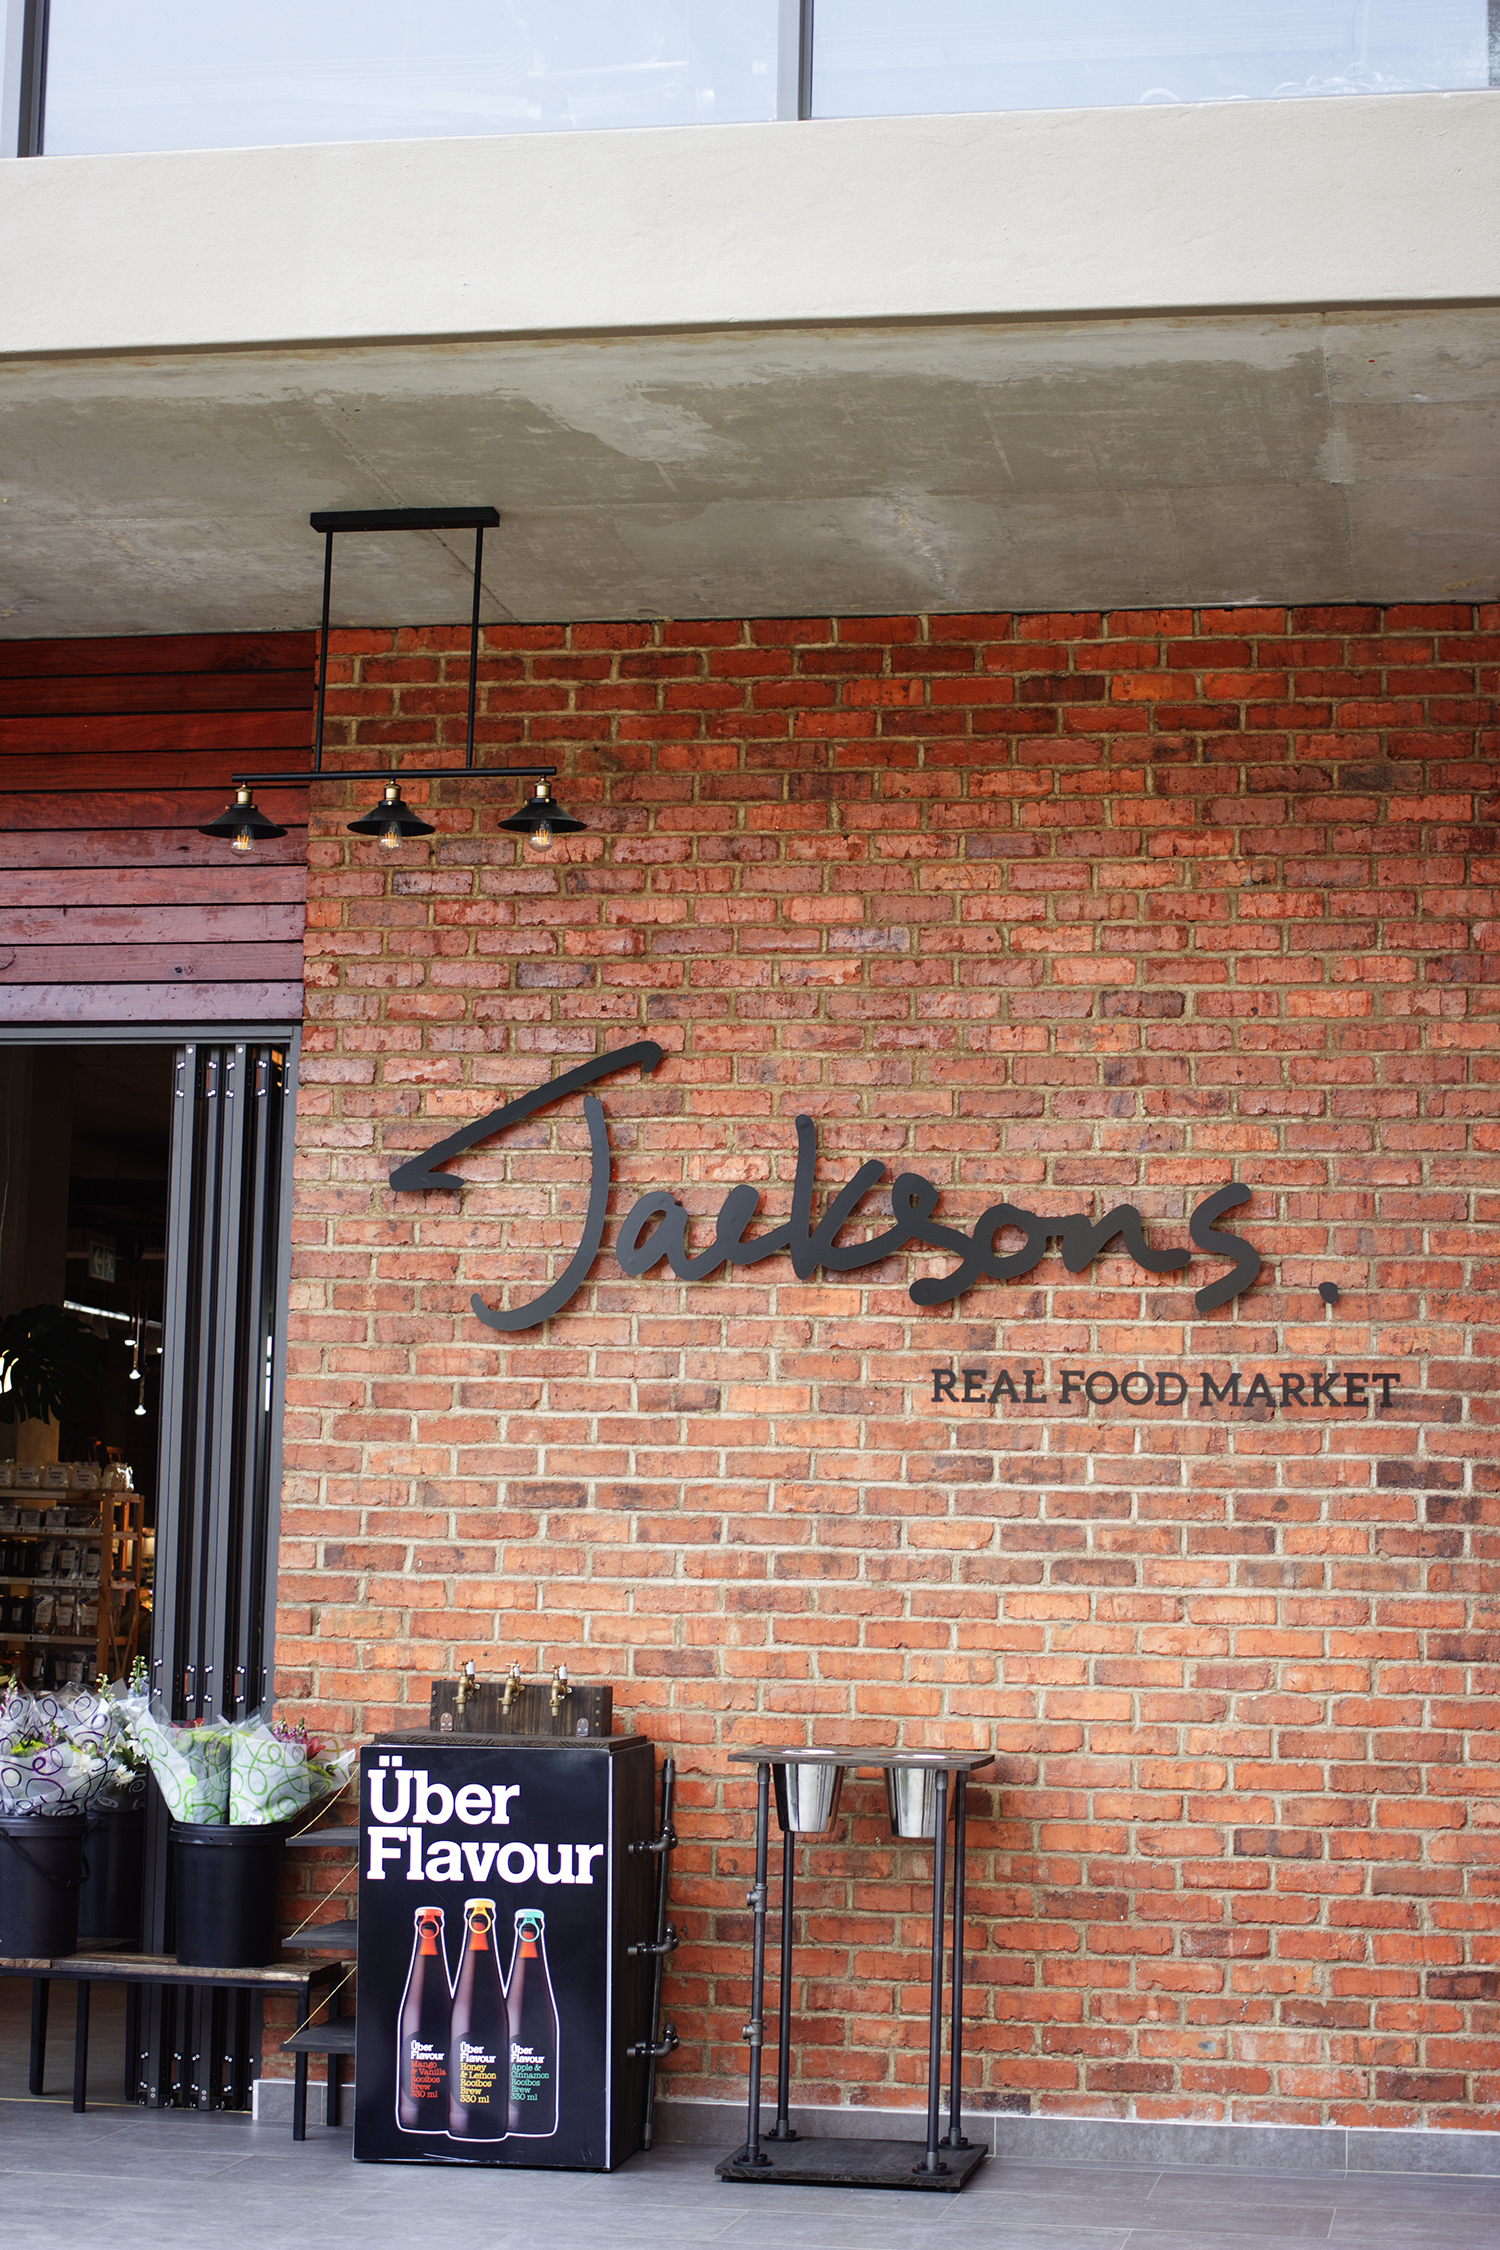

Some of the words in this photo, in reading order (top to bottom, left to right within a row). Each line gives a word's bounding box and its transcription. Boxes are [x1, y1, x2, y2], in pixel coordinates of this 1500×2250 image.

[931, 1368, 1047, 1404] REAL
[1059, 1369, 1188, 1406] FOOD
[1200, 1372, 1401, 1408] MARKET
[367, 1755, 520, 1825] Über
[366, 1826, 604, 1884] Flavour
[410, 2040, 434, 2051] Über
[460, 2041, 485, 2054] Über
[510, 2043, 534, 2054] Über
[410, 2051, 445, 2060] Flavour
[459, 2053, 497, 2063] Flavour
[510, 2054, 546, 2063] Flavour
[410, 2060, 437, 2069] Mango
[460, 2063, 487, 2073] Honey
[511, 2064, 533, 2072] Apple
[410, 2067, 418, 2075] &
[418, 2068, 446, 2076] Vanilla
[460, 2071, 468, 2079] &
[468, 2071, 497, 2079] Lemon
[510, 2071, 550, 2079] Cinnamon
[410, 2075, 440, 2083] Rooibos
[460, 2079, 493, 2088] Rooibos
[511, 2078, 541, 2087] Rooibos
[410, 2082, 431, 2090] Brew
[410, 2089, 426, 2098] 330
[460, 2087, 482, 2095] Brew
[460, 2095, 477, 2103] 330
[477, 2095, 490, 2104] ml
[510, 2093, 526, 2101] 330
[527, 2093, 538, 2101] ml
